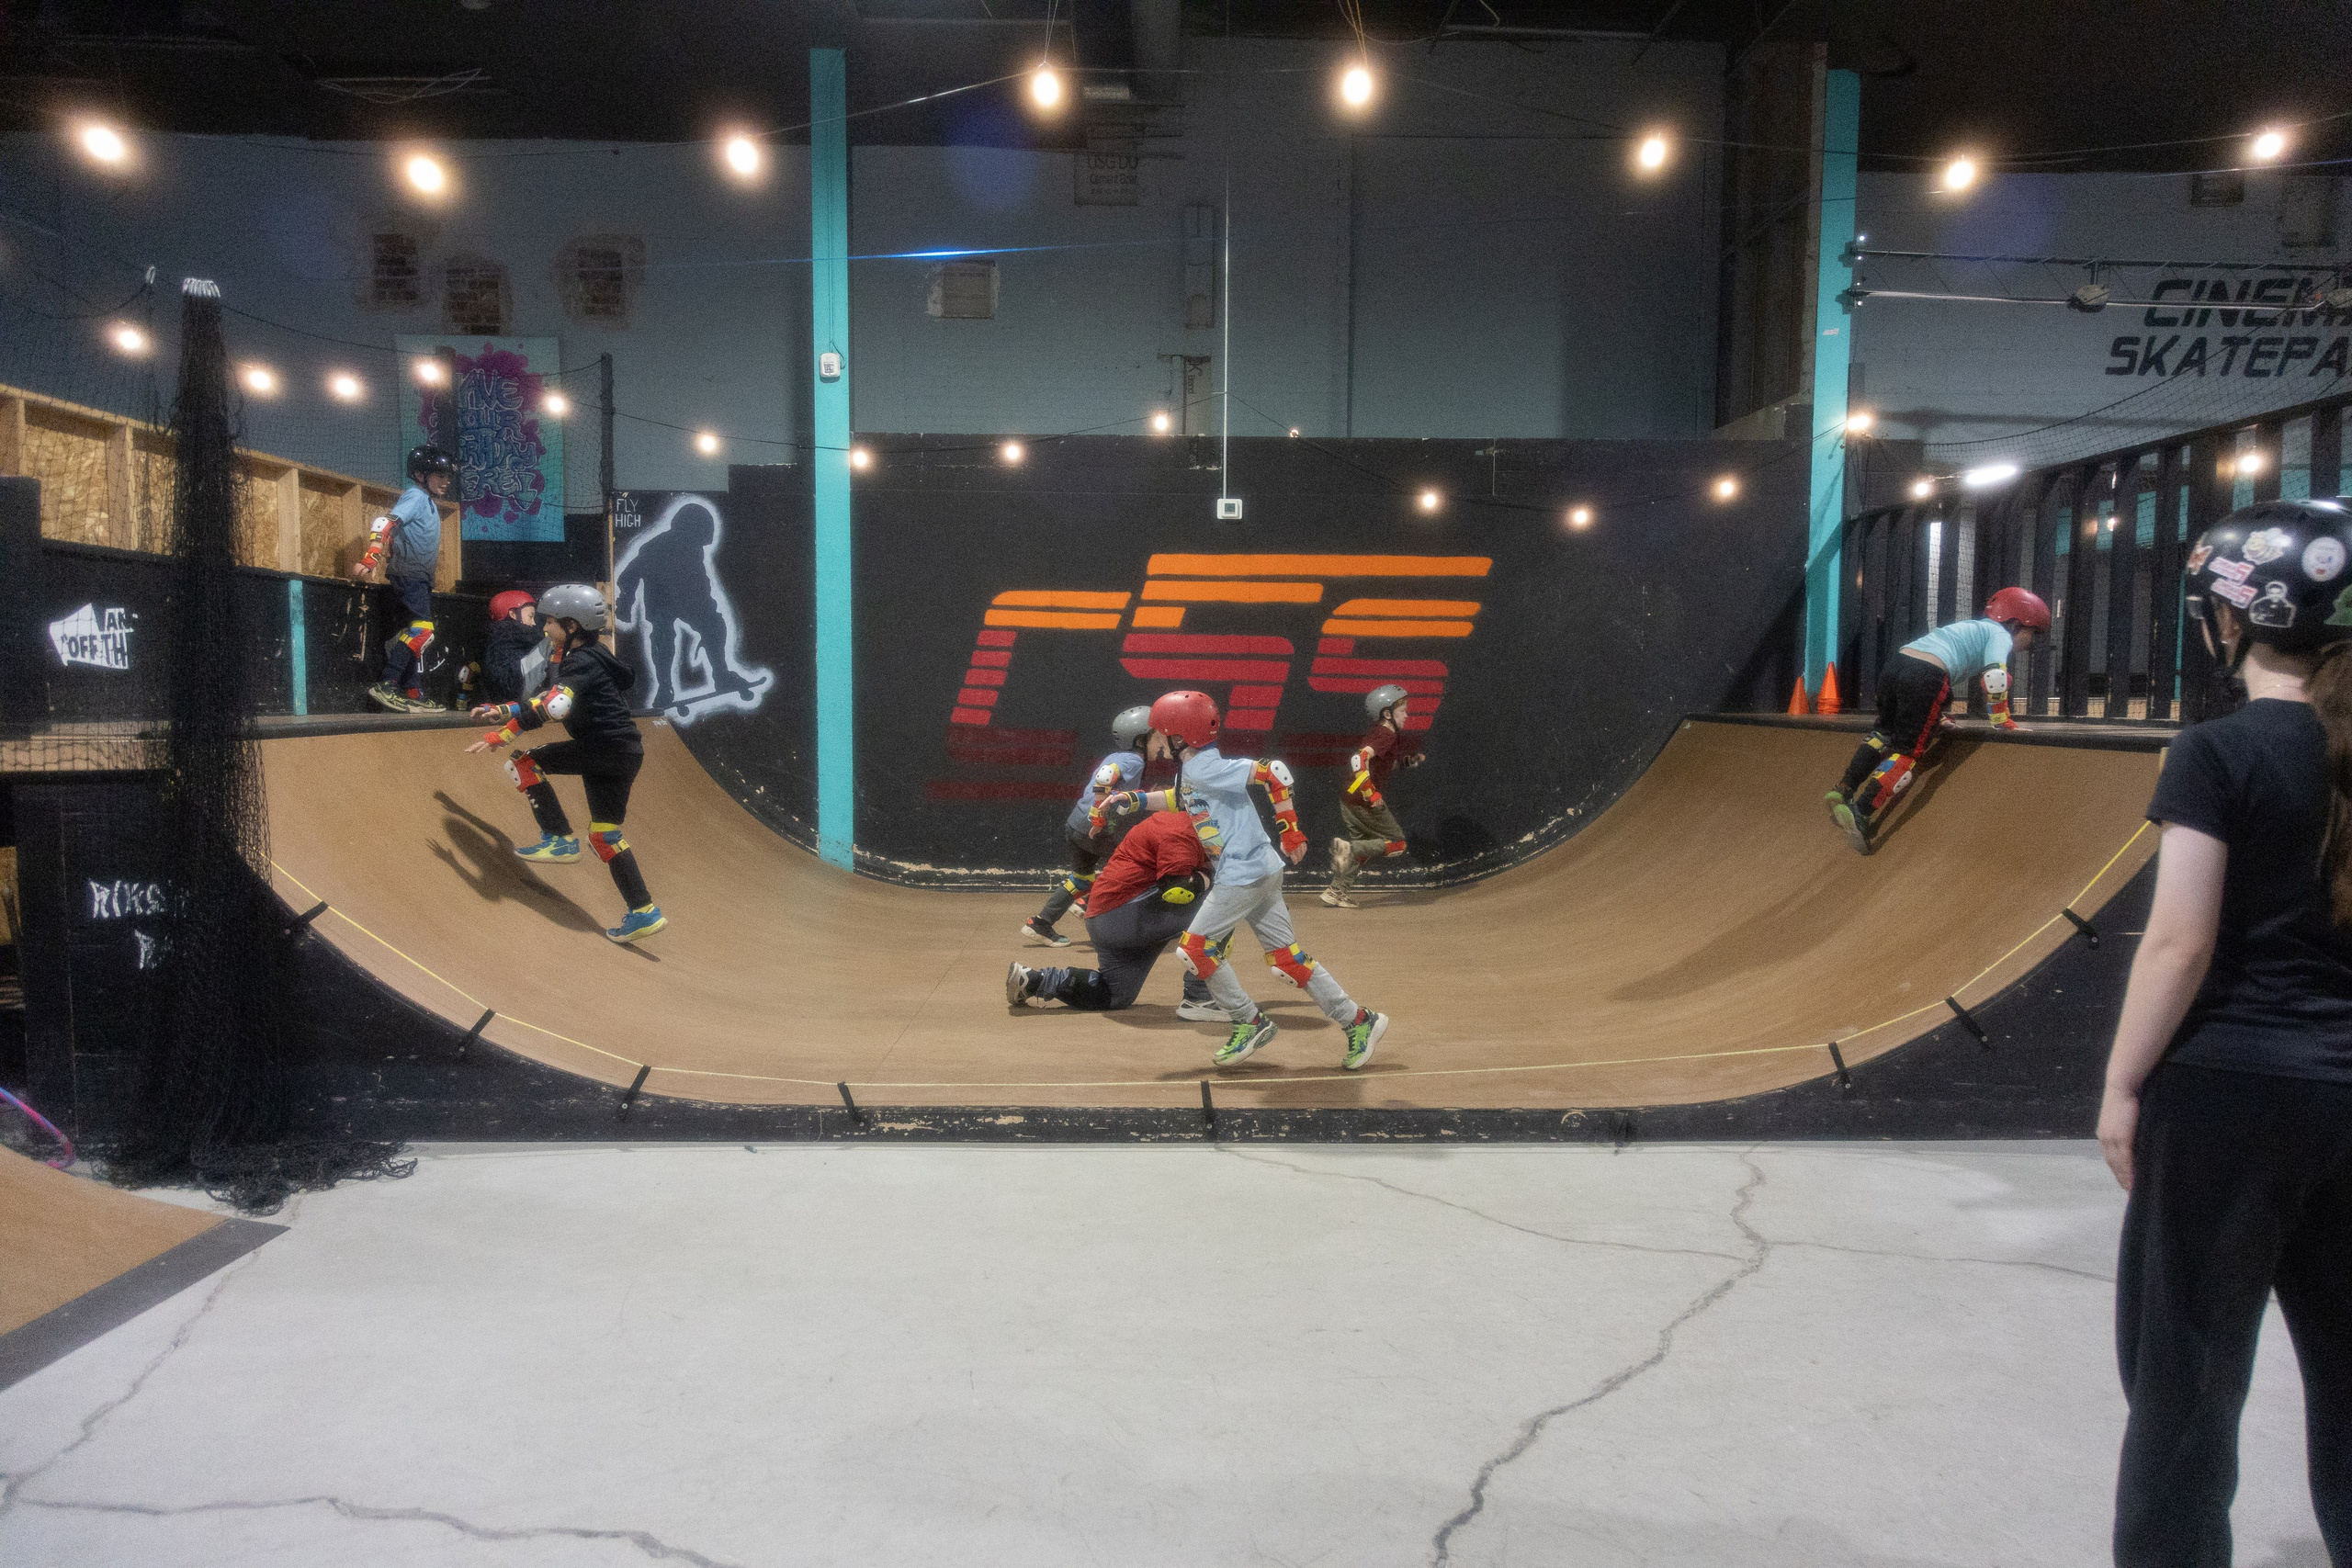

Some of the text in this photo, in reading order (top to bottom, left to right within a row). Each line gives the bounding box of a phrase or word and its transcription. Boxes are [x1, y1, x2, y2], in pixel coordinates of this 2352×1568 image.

[2143, 279, 2352, 327] CINEM
[2105, 335, 2352, 378] SKATEPA
[435, 368, 524, 410] AVE
[458, 462, 537, 511] ERE!
[616, 497, 639, 513] FLY
[615, 513, 641, 528] HIGH
